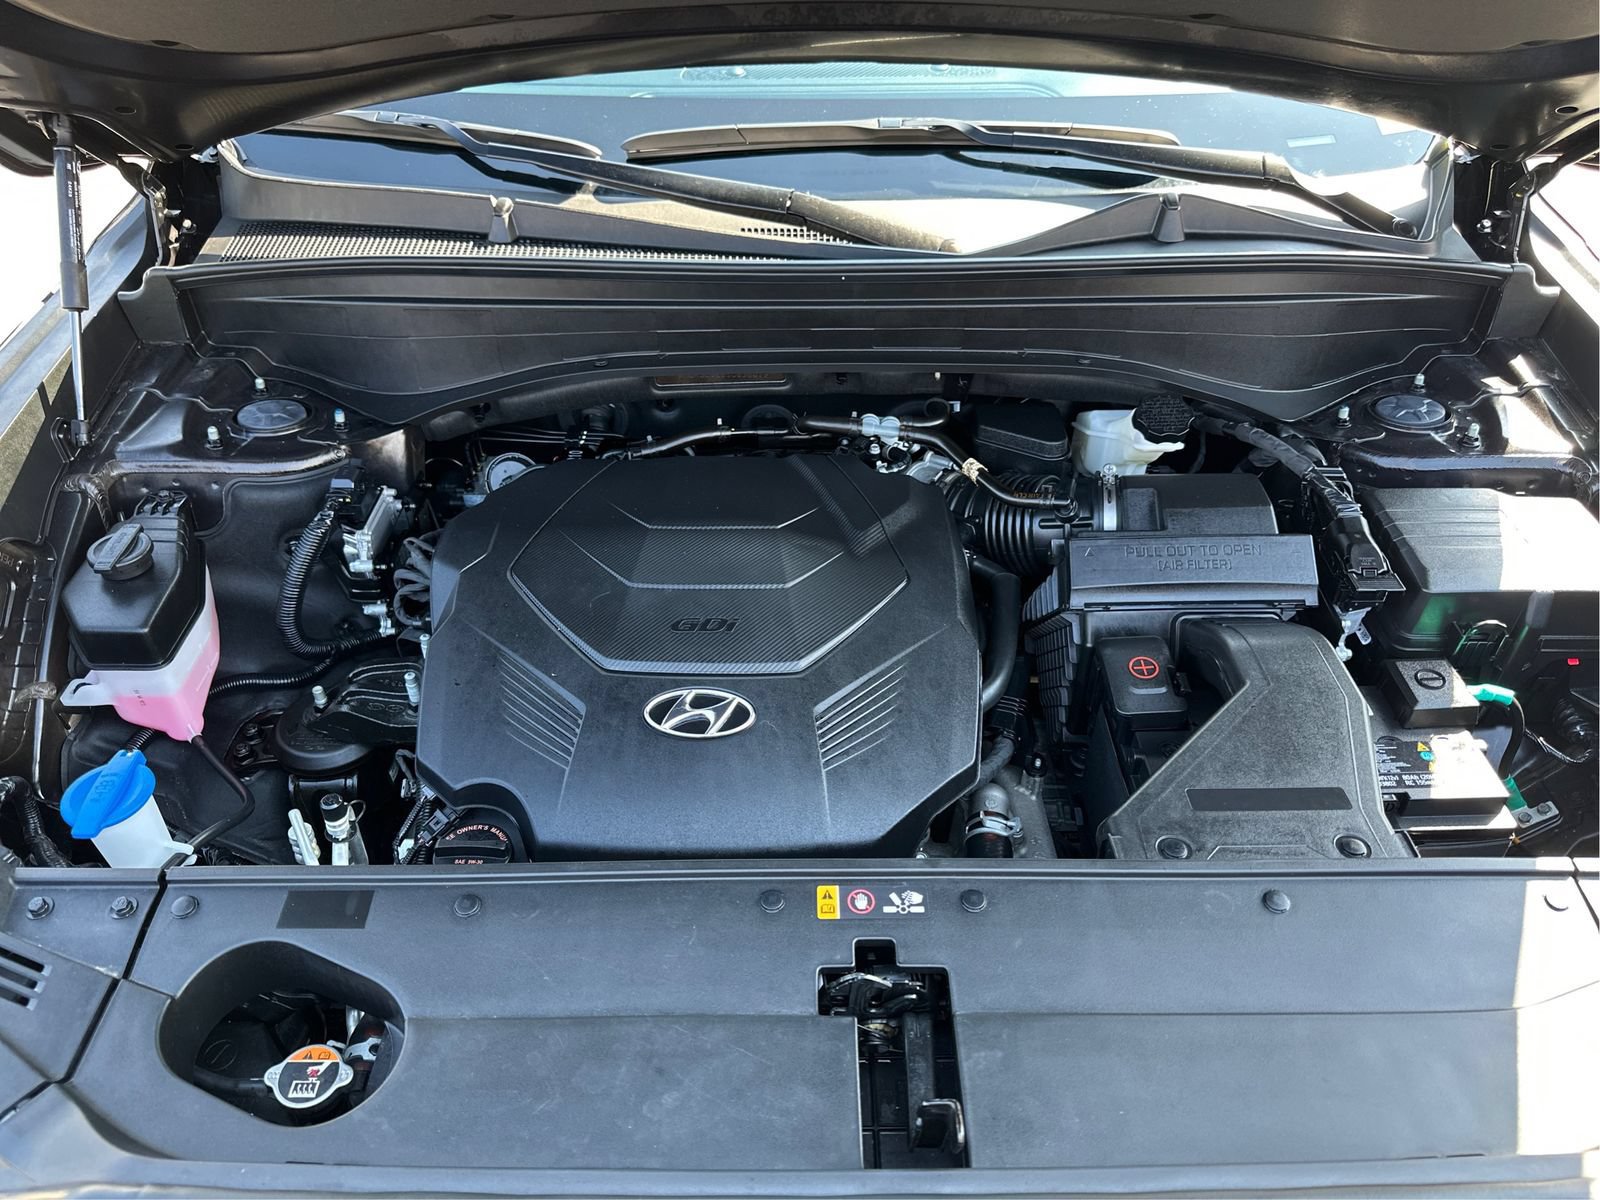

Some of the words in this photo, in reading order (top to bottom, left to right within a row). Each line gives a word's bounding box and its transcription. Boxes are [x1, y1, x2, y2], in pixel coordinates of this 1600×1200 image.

[1125, 544, 1162, 558] PULL
[1167, 545, 1195, 557] OUT
[1200, 545, 1218, 556] TO
[1223, 544, 1262, 556] OPEN
[457, 825, 489, 835] OWNER'S
